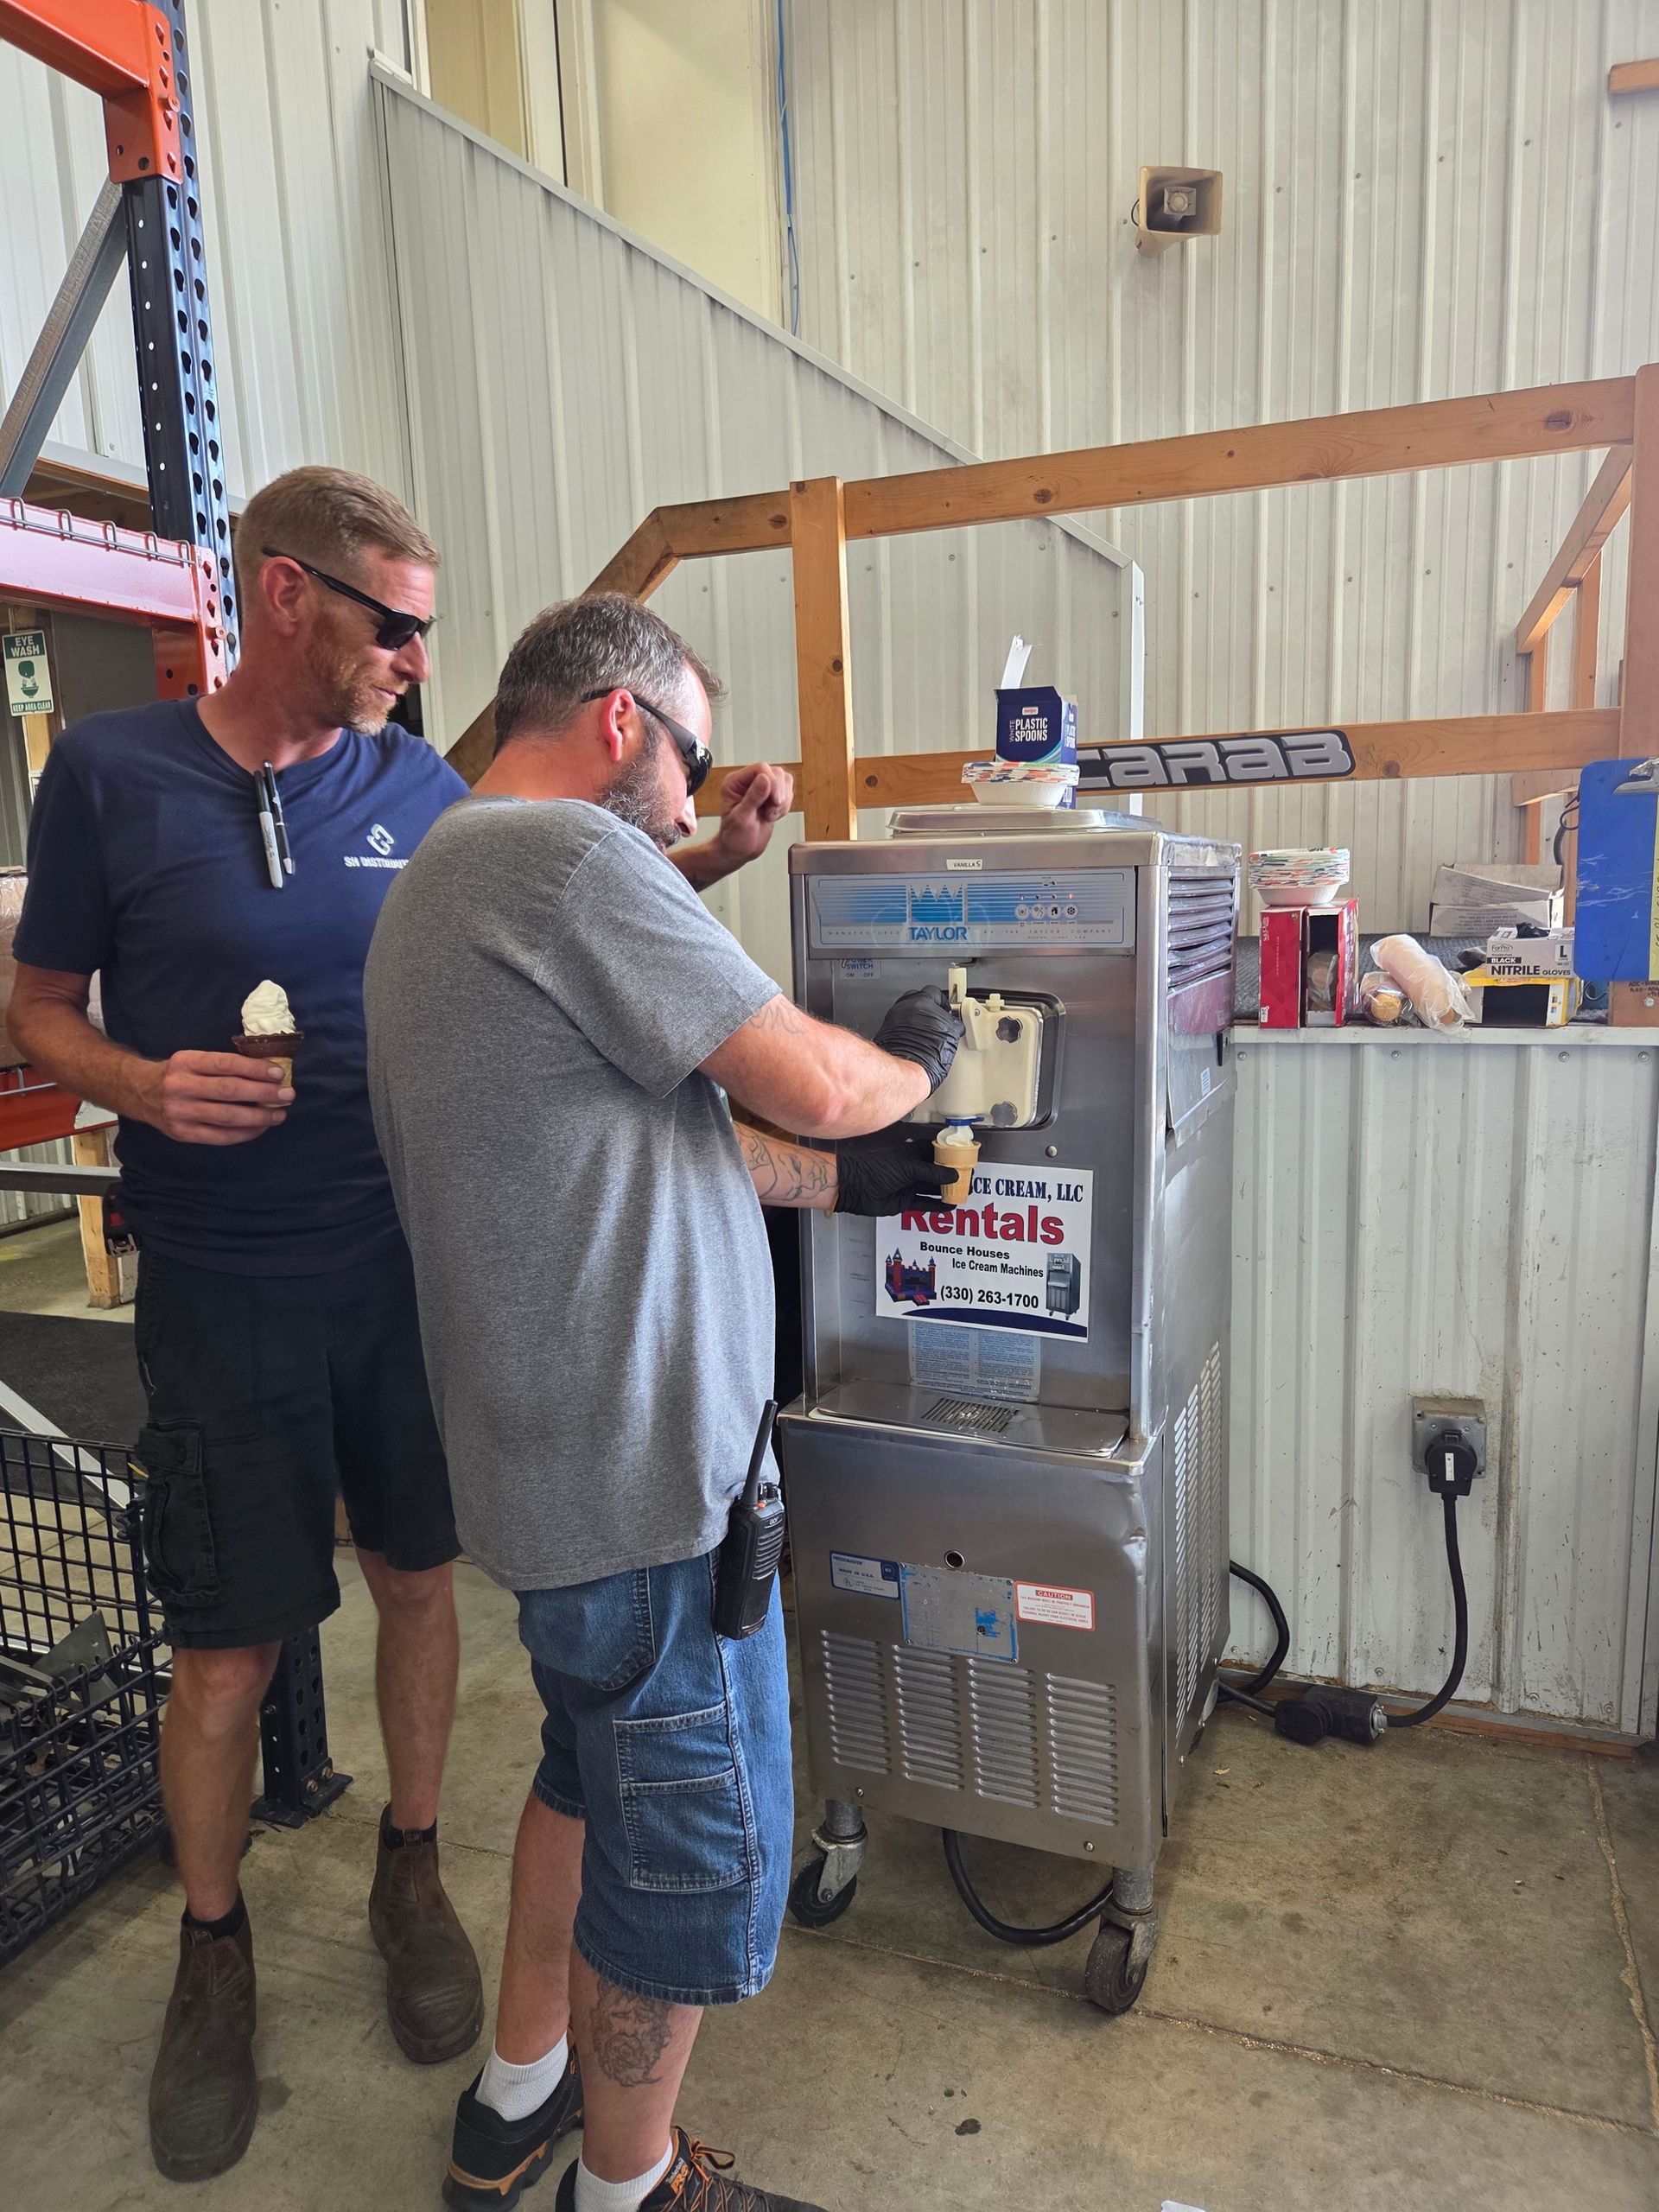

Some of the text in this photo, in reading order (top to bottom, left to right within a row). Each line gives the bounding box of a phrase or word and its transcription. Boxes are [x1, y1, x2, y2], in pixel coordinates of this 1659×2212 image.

[15, 635, 35, 647] EYE
[10, 645, 40, 658] WASH
[12, 701, 52, 713] KEEP AREA CLEAR
[1015, 718, 1048, 730] PLASTIC
[1015, 729, 1048, 742] SPOONS
[908, 926, 968, 941] TAYLOR
[1560, 945, 1567, 958] L
[1491, 965, 1541, 976] NITRILE
[995, 1179, 1052, 1203] CREAM,
[1057, 1183, 1084, 1203] LLC
[920, 1241, 1010, 1260] Bounce Houses
[952, 1258, 1044, 1278] Ice Cream Machines
[940, 1285, 1039, 1309] (330) 263-1700
